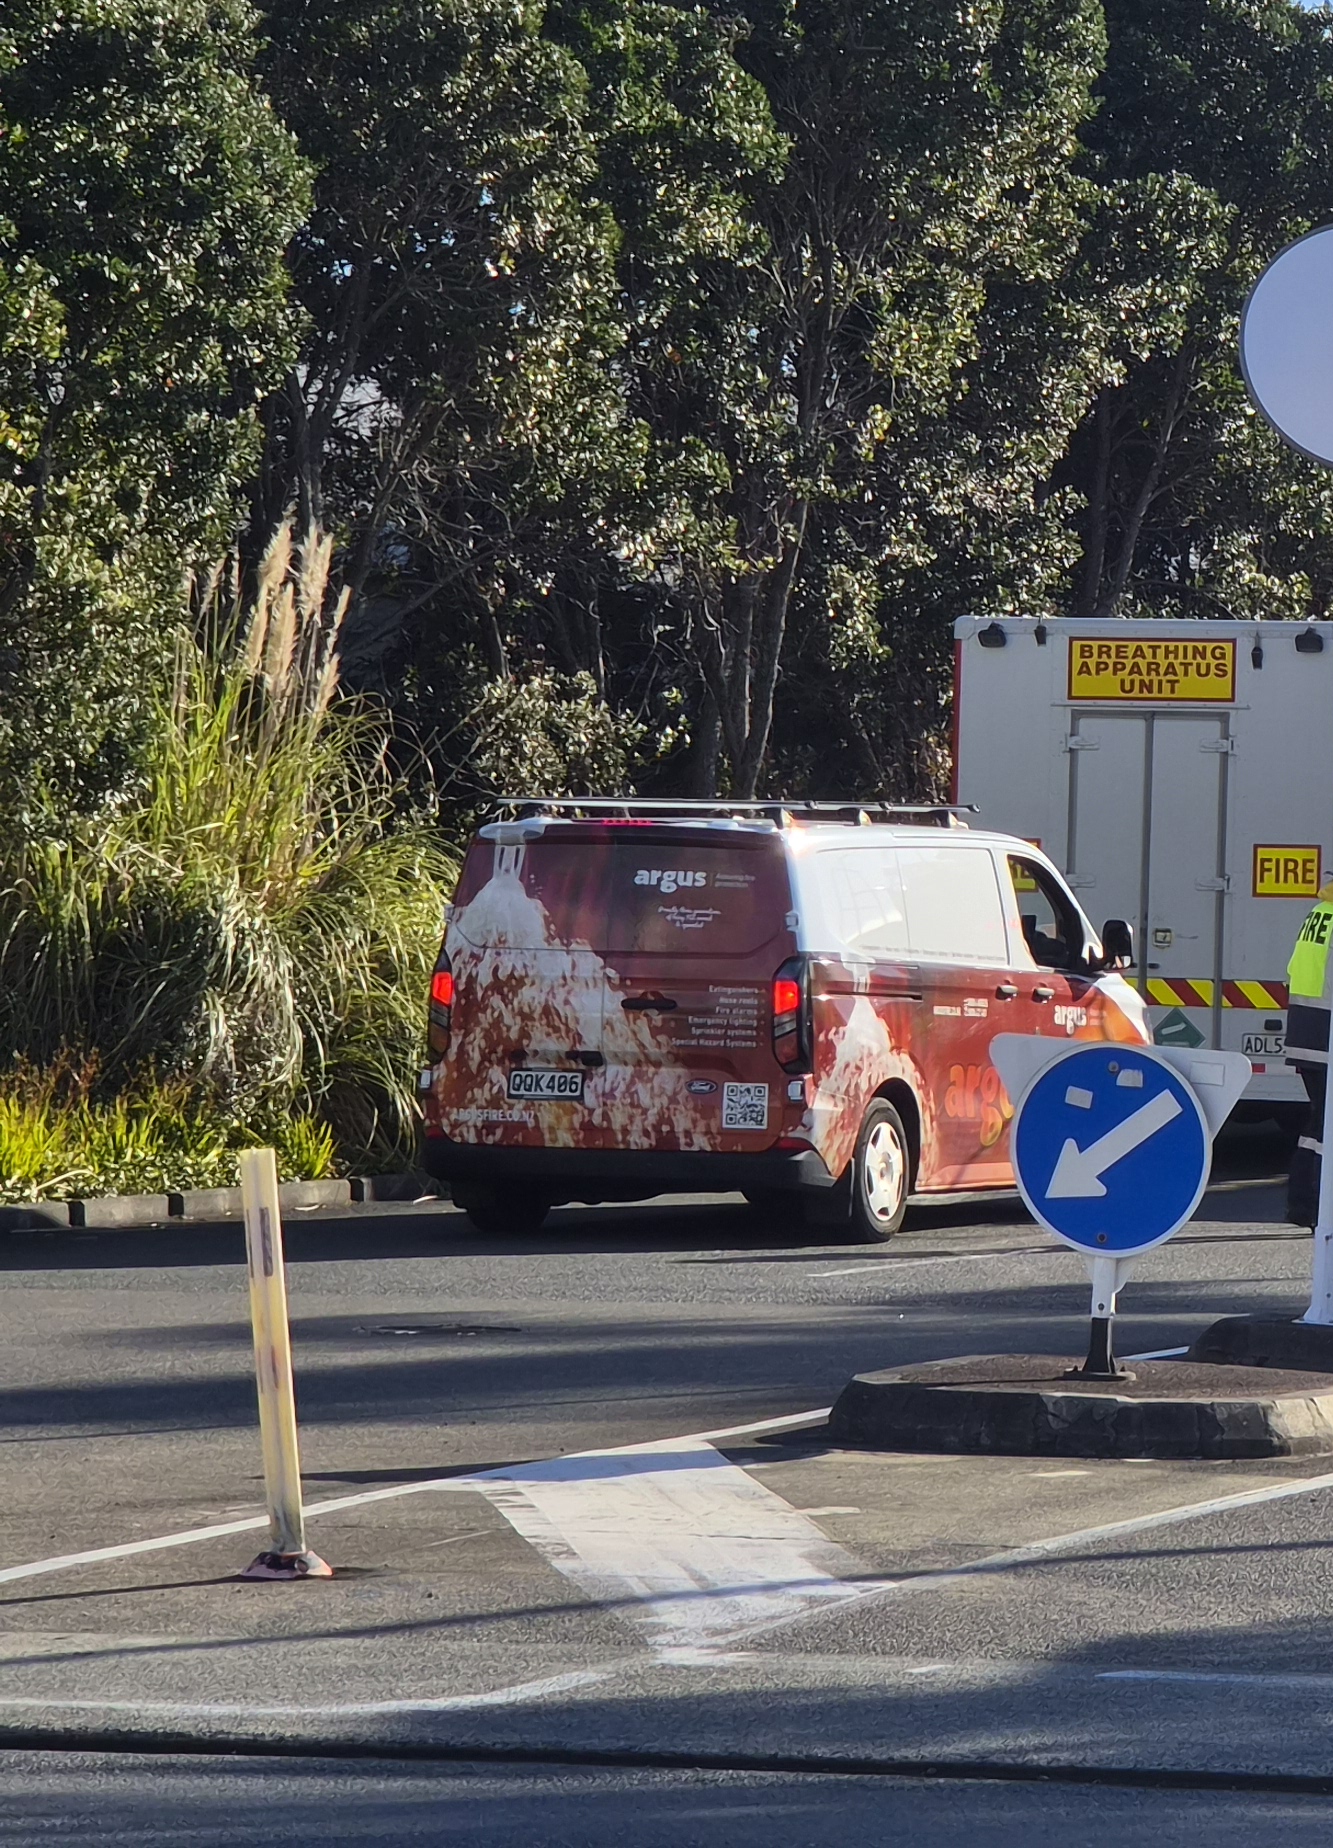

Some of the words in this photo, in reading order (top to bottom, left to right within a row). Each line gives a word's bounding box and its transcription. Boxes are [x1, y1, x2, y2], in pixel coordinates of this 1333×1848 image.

[1079, 643, 1227, 661] BREATHING
[1076, 661, 1229, 678] APPARATUS
[1119, 678, 1180, 695] UNIT
[634, 869, 707, 893] argus
[1259, 858, 1316, 885] FIRE
[1297, 911, 1333, 945] FIRE
[1054, 1005, 1087, 1036] argus
[512, 1072, 580, 1094] QQK406
